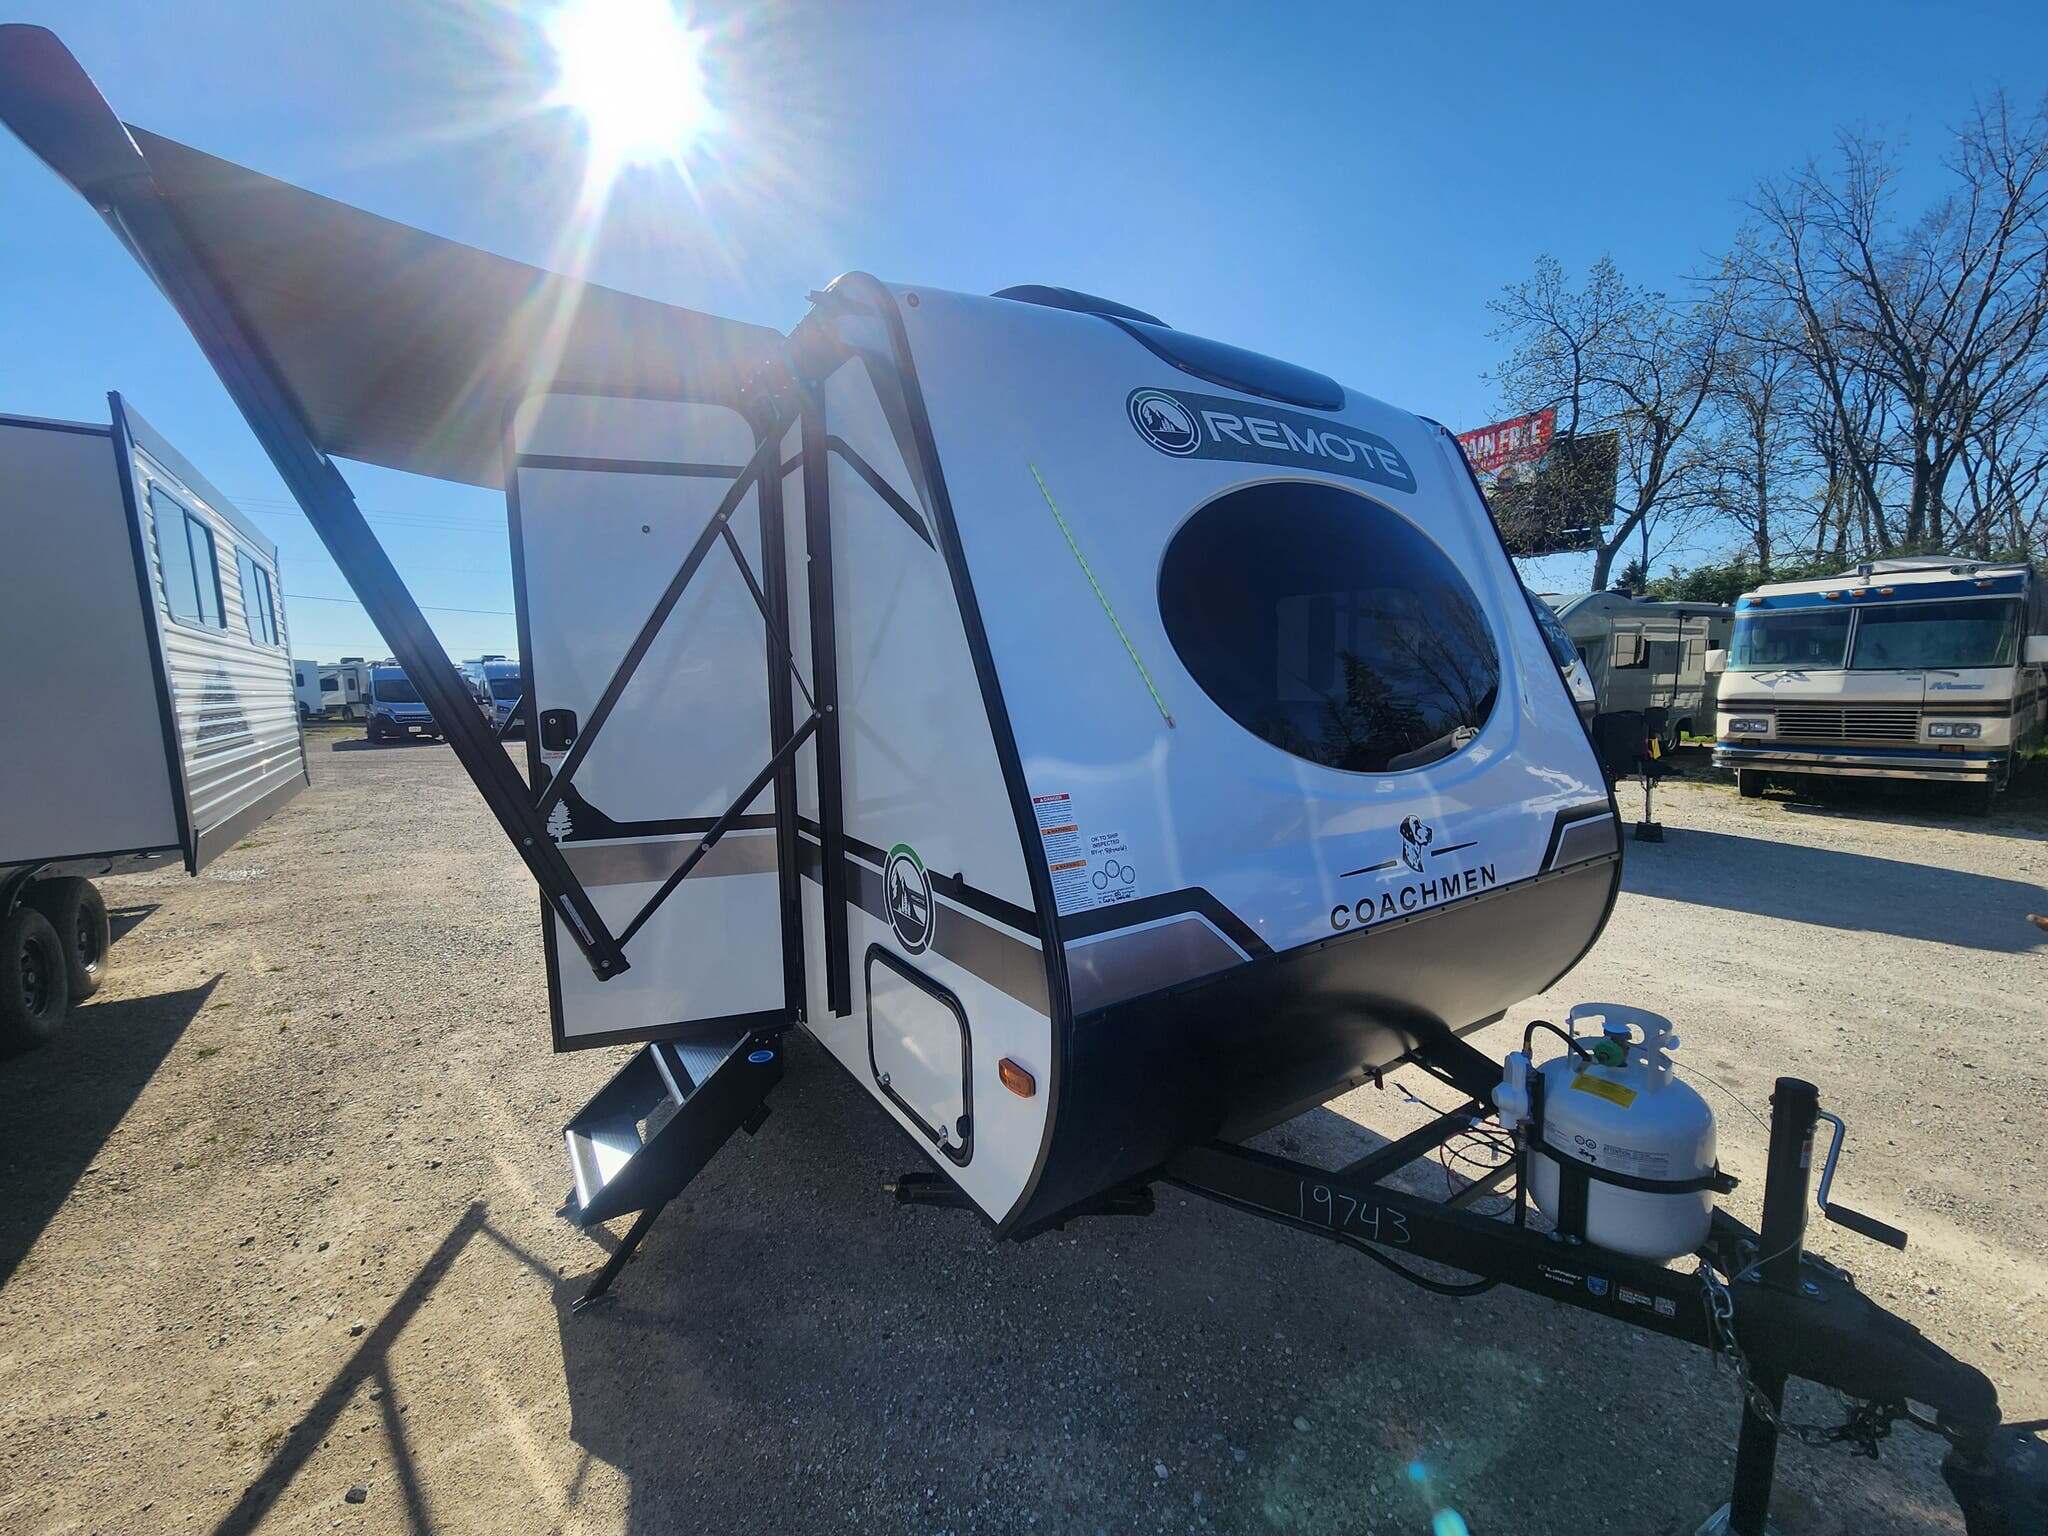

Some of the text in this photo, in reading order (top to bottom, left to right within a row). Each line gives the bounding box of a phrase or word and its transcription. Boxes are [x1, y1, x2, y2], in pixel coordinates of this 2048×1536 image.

[1201, 410, 1407, 479] REMOTE
[1330, 864, 1496, 931] COACHMEN
[1300, 1180, 1411, 1243] 19743
